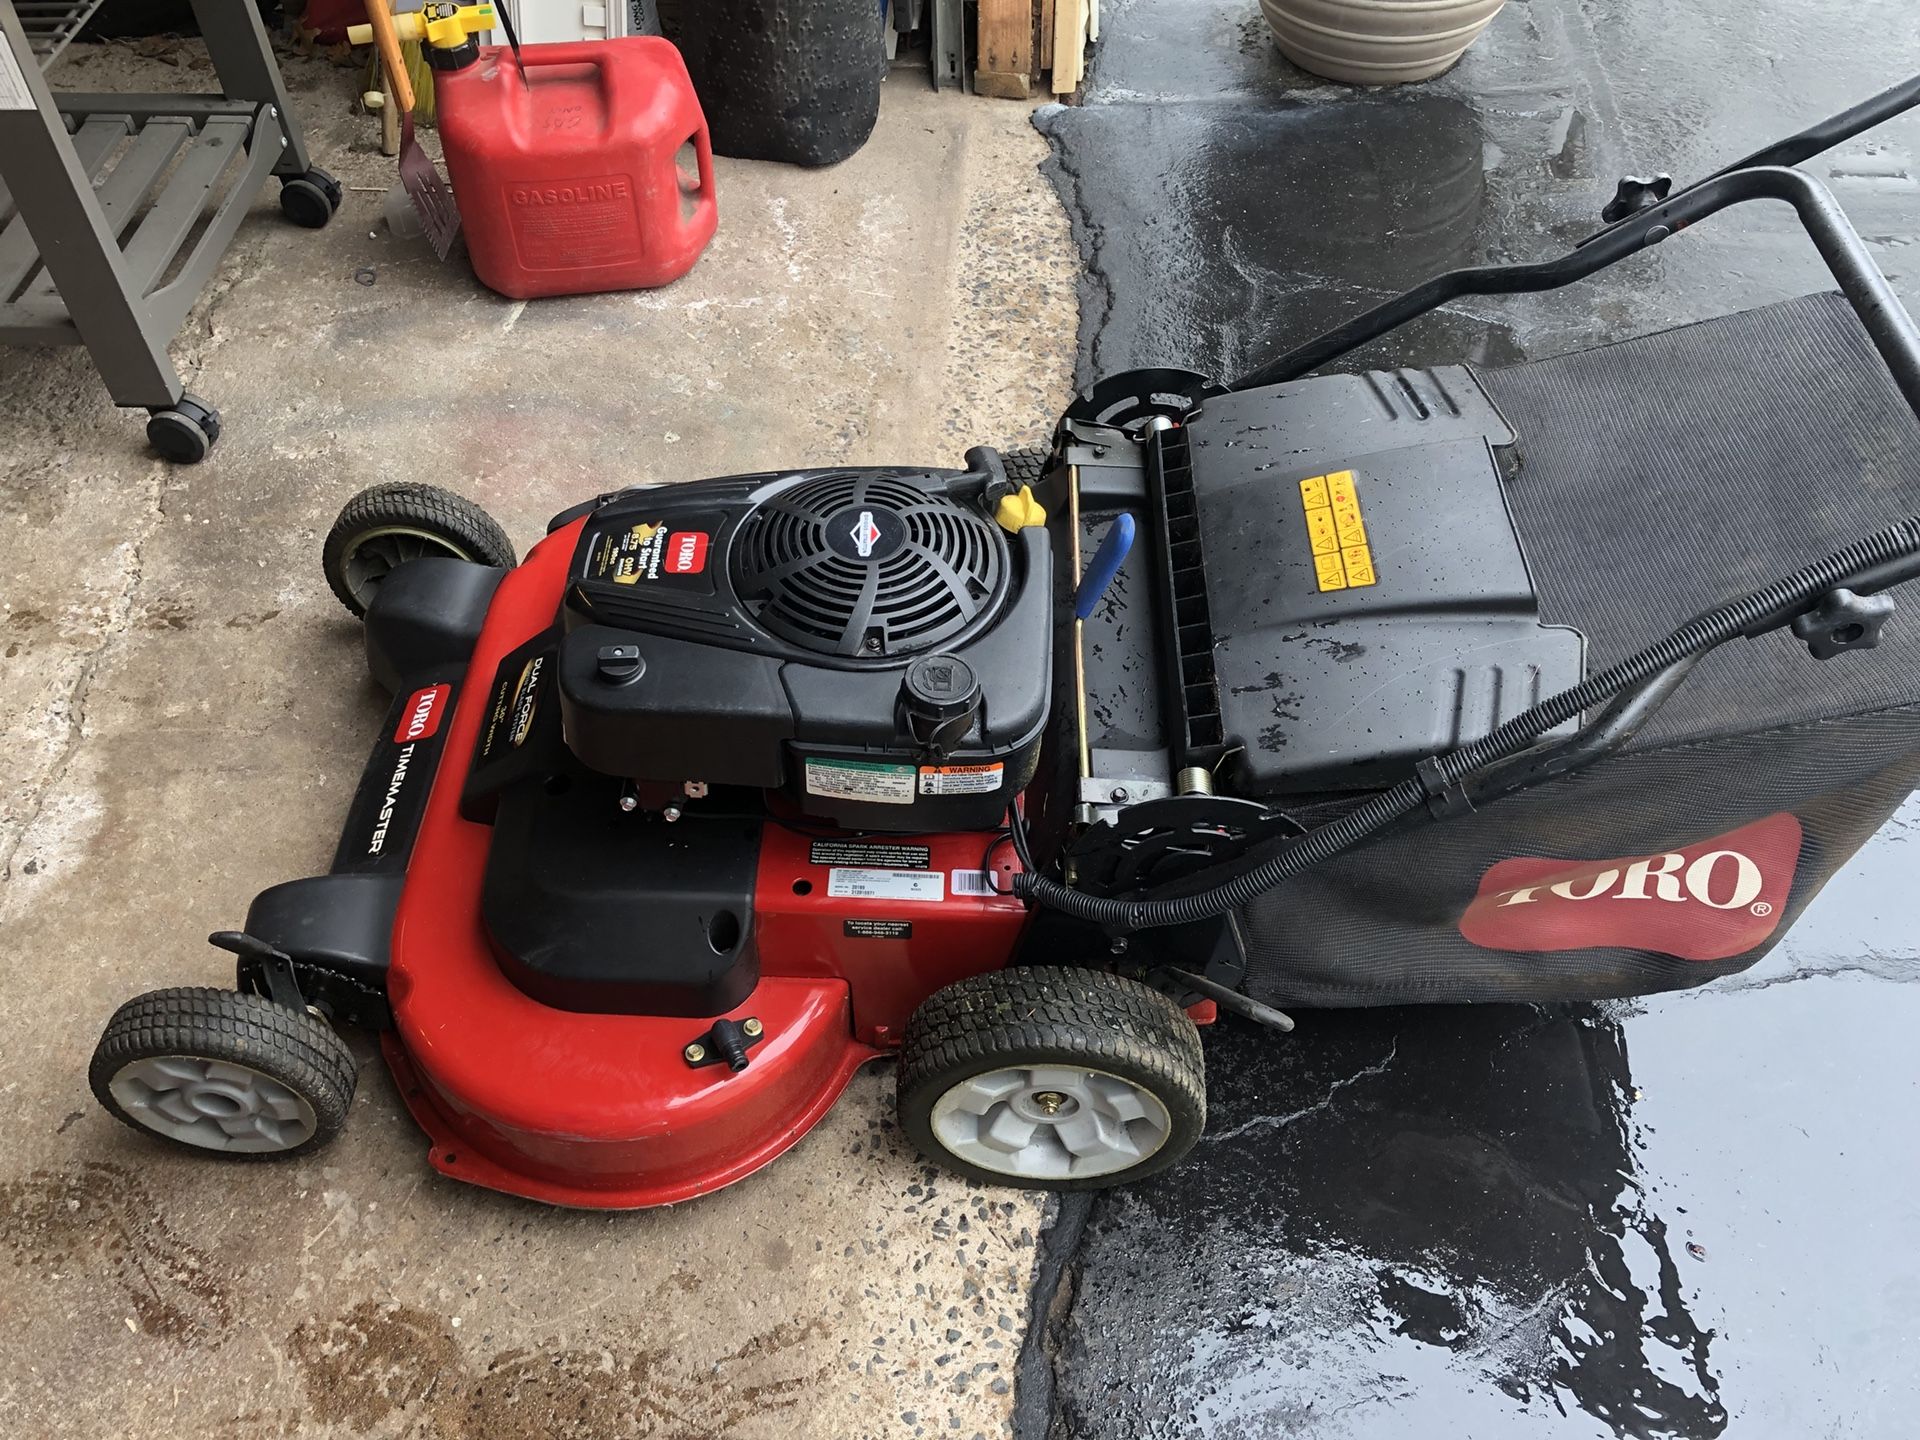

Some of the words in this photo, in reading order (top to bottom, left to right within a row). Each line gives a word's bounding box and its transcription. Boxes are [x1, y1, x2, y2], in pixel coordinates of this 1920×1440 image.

[631, 5, 642, 31] LONG
[511, 182, 628, 206] GASOLINE
[629, 533, 640, 550] 8.75
[638, 547, 652, 569] Start
[643, 537, 653, 546] to
[648, 526, 668, 580] Guaranteed
[677, 535, 697, 572] TORO
[623, 557, 634, 576] OHV
[527, 657, 544, 693] DUAL
[408, 689, 437, 738] TORO
[492, 681, 508, 722] CUTTING
[514, 695, 532, 742] FORCE
[483, 723, 496, 756] WIDTH
[949, 766, 991, 774] WARNING
[368, 743, 415, 854] TIMEMASTER
